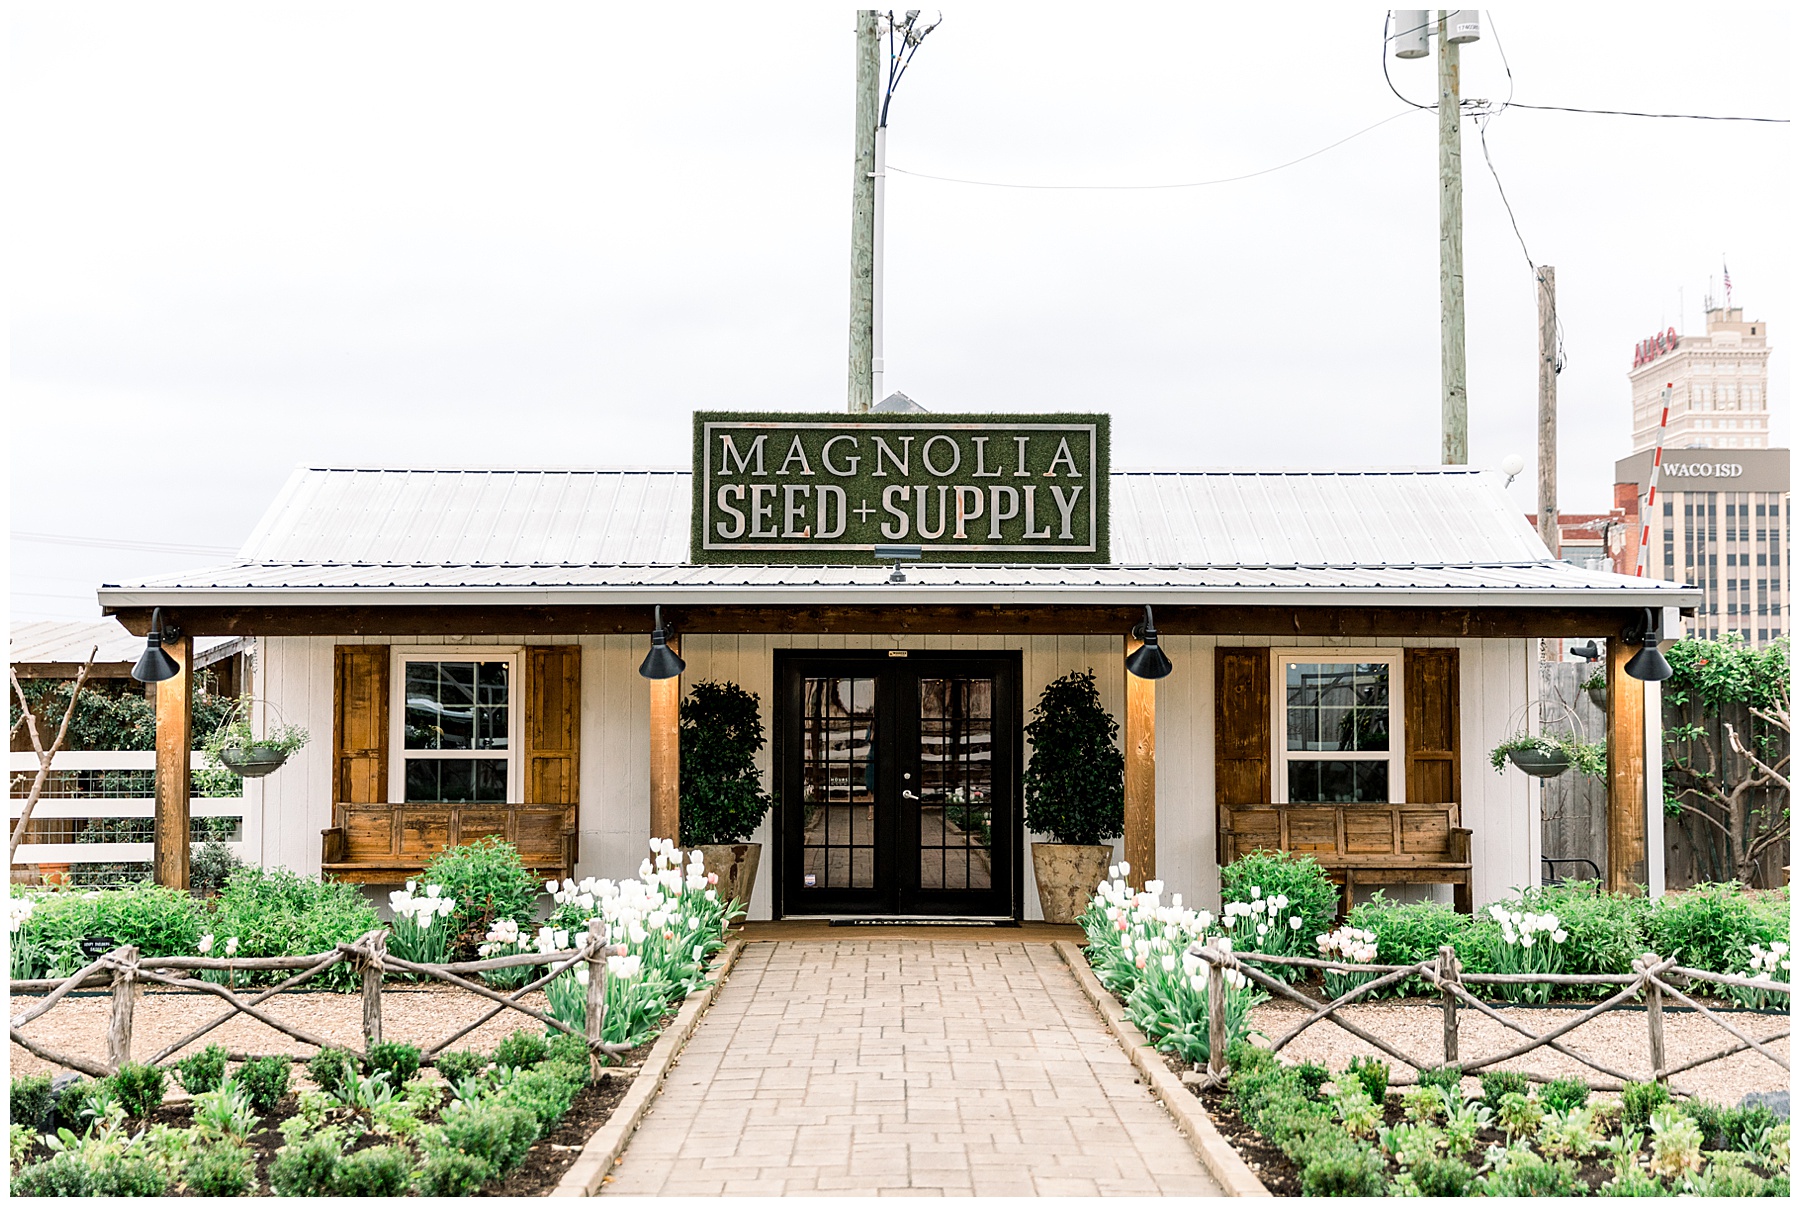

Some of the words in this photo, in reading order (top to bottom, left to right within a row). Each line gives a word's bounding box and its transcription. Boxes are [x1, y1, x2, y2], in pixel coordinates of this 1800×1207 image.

[1633, 326, 1677, 368] ALICO
[717, 434, 1082, 477] MAGNOLIA
[1662, 462, 1713, 478] WACO
[1714, 463, 1743, 478] ISD
[716, 483, 847, 539] SEED
[880, 484, 1084, 540] SUPPLY
